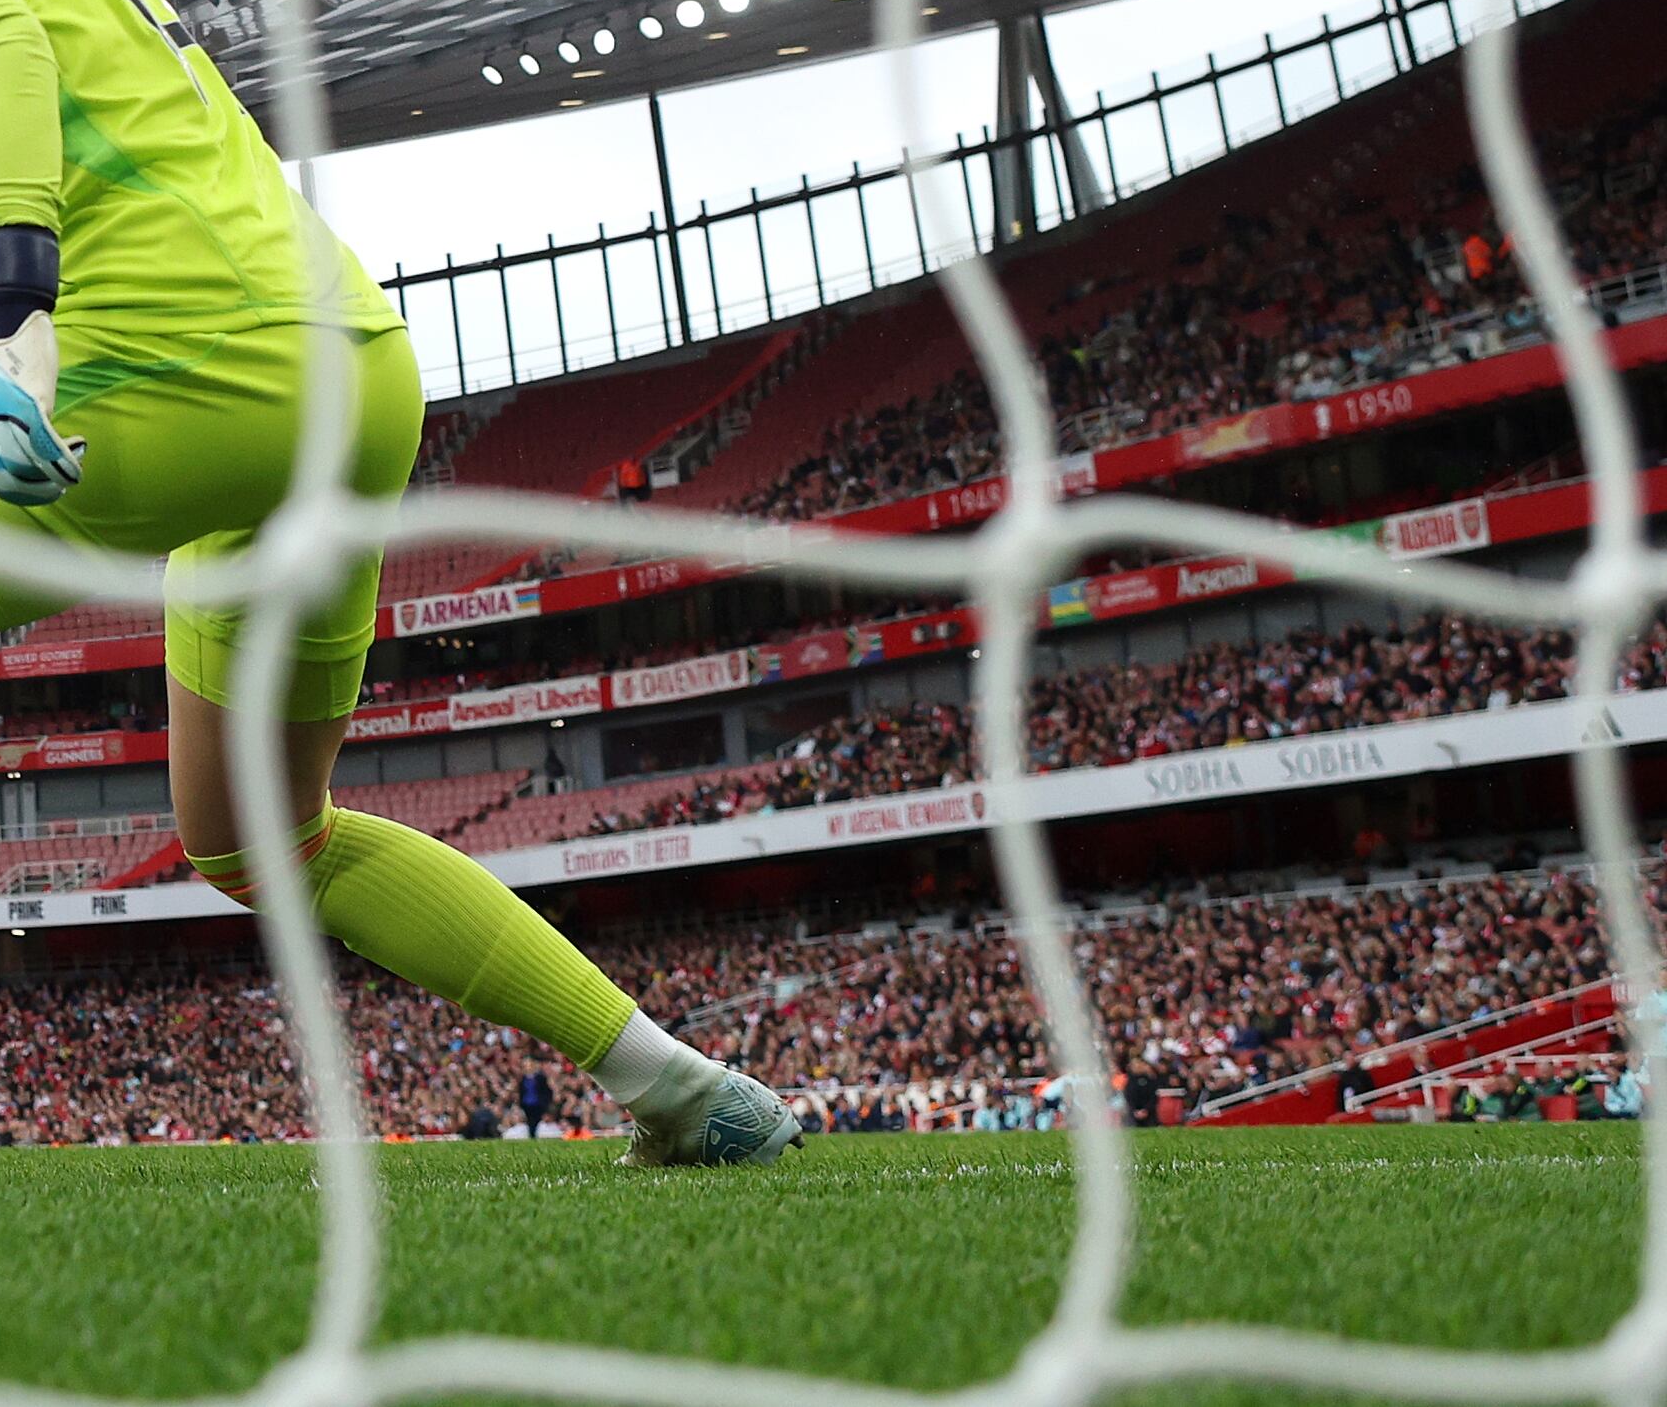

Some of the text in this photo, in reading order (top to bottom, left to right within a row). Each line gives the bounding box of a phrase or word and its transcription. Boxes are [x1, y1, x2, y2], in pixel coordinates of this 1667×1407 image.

[420, 590, 513, 627] ARMENIA
[344, 708, 448, 739] rsenal.com
[1145, 739, 1385, 797] SOBHA SOBHA
